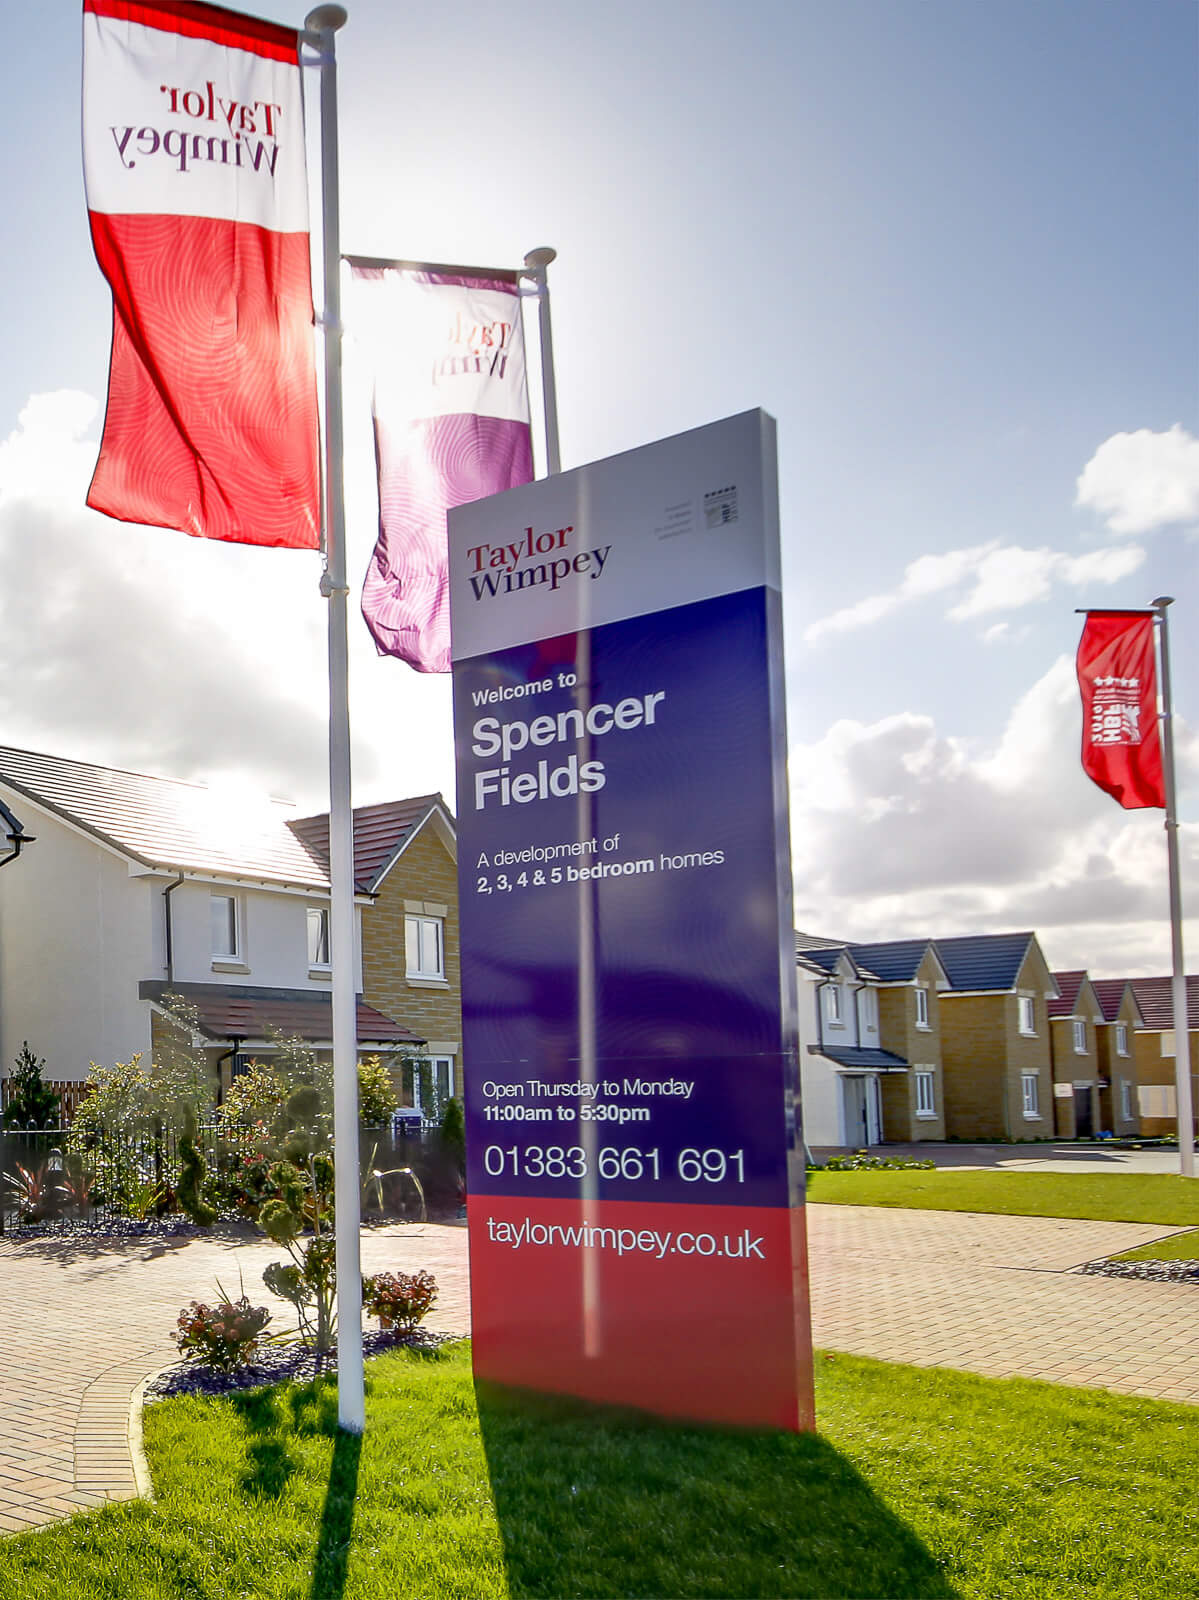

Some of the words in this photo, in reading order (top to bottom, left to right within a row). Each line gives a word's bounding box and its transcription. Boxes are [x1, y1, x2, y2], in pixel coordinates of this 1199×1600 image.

[467, 526, 574, 573] Taylor
[468, 545, 612, 601] Wimpey
[471, 677, 553, 706] Welcome
[558, 672, 577, 688] to
[472, 691, 665, 761] Spencer
[475, 754, 606, 810] Fields
[477, 852, 490, 868] A
[494, 837, 598, 867] development
[603, 833, 621, 852] of
[477, 877, 493, 894] 2,
[497, 874, 513, 892] 3,
[517, 871, 529, 887] 4
[532, 869, 546, 886] &
[551, 867, 563, 884] 5
[567, 858, 655, 883] bedroom
[660, 850, 725, 871] homes
[482, 1080, 524, 1100] Open
[527, 1080, 599, 1100] Thursday
[603, 1079, 620, 1096] to
[624, 1077, 695, 1099] Monday
[483, 1105, 552, 1121] 11:00am
[556, 1105, 576, 1121] to
[580, 1104, 651, 1125] 5:30pm
[484, 1145, 588, 1178] 01383
[598, 1147, 660, 1180] 661
[677, 1148, 745, 1183] 691
[486, 1216, 767, 1259] taylorwimpey.co.uk
